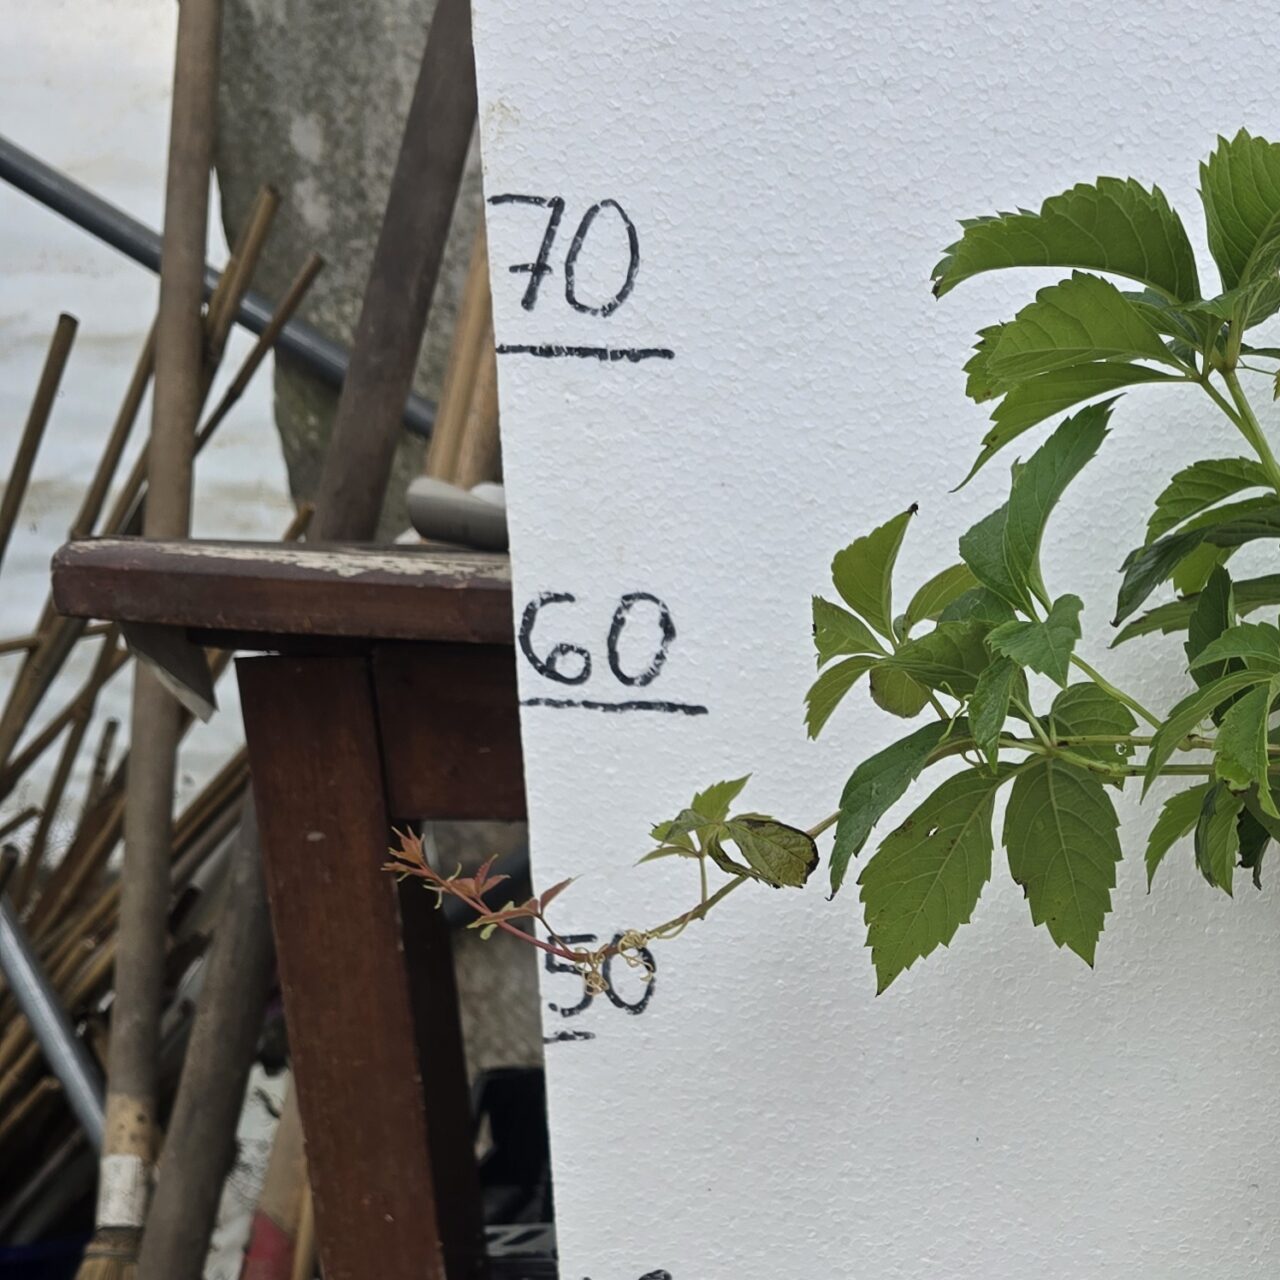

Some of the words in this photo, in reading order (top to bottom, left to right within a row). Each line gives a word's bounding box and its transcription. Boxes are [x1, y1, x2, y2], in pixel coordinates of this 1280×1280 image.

[487, 193, 640, 318] 70
[519, 591, 677, 687] 60
[545, 932, 657, 1018] 50
